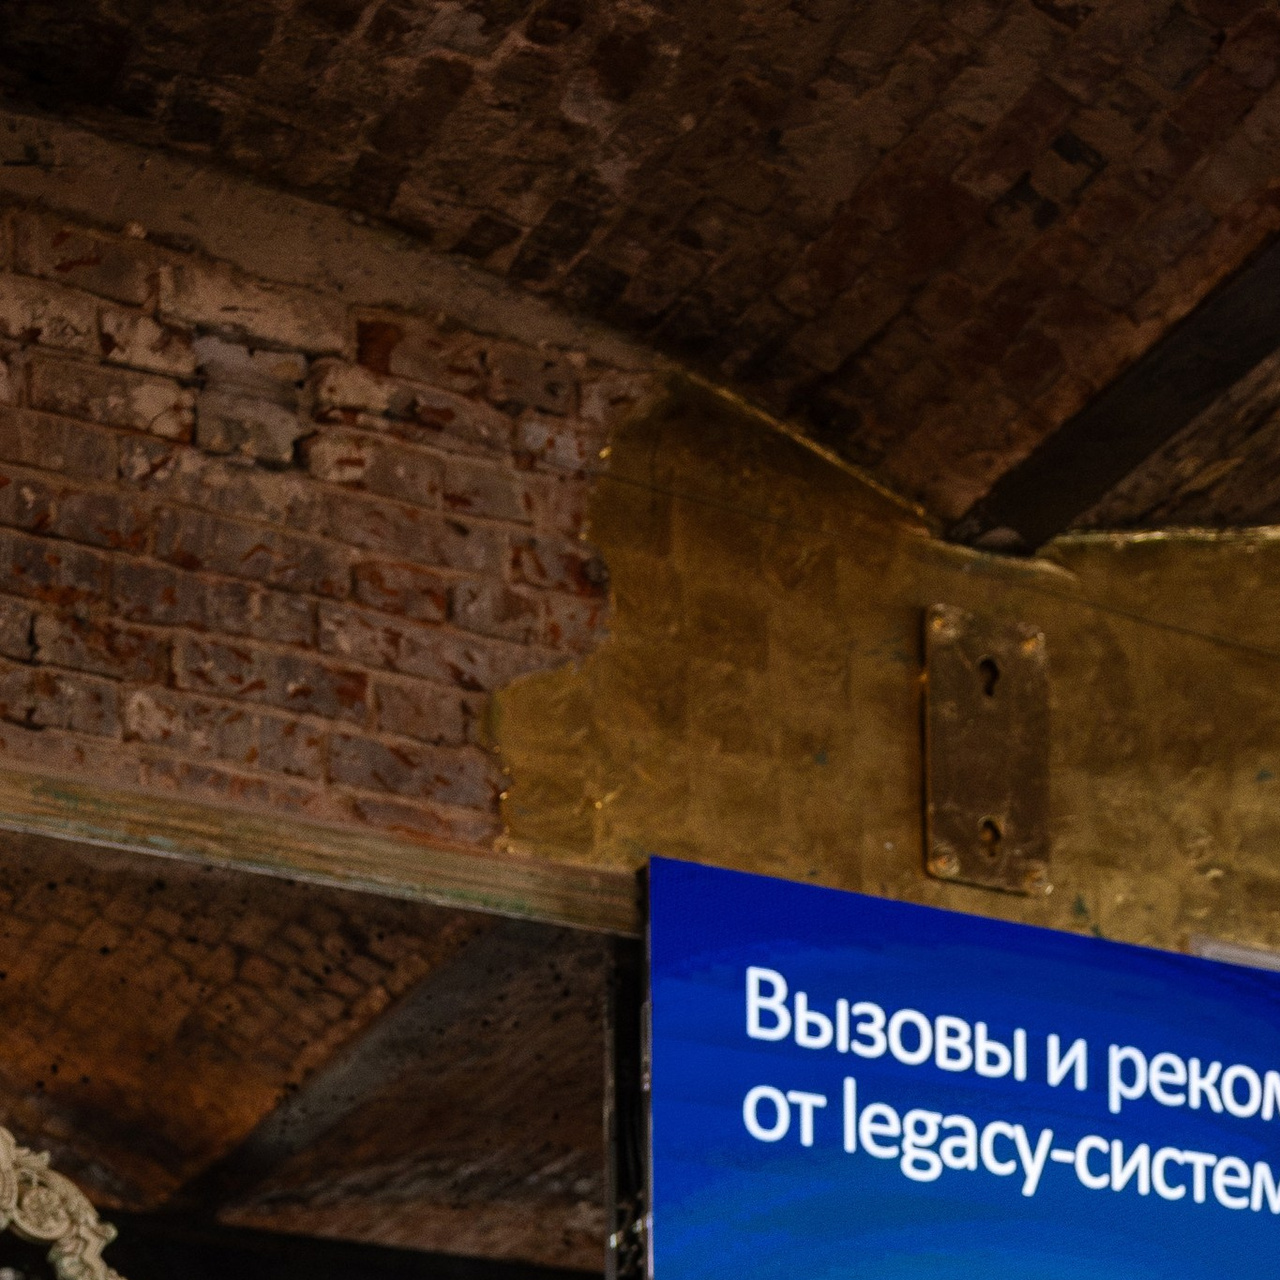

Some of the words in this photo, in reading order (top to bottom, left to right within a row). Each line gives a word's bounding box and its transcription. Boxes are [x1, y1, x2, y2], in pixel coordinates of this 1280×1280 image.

[745, 966, 1027, 1081] Вызовы
[1047, 1034, 1087, 1091] и
[743, 1084, 827, 1147] от
